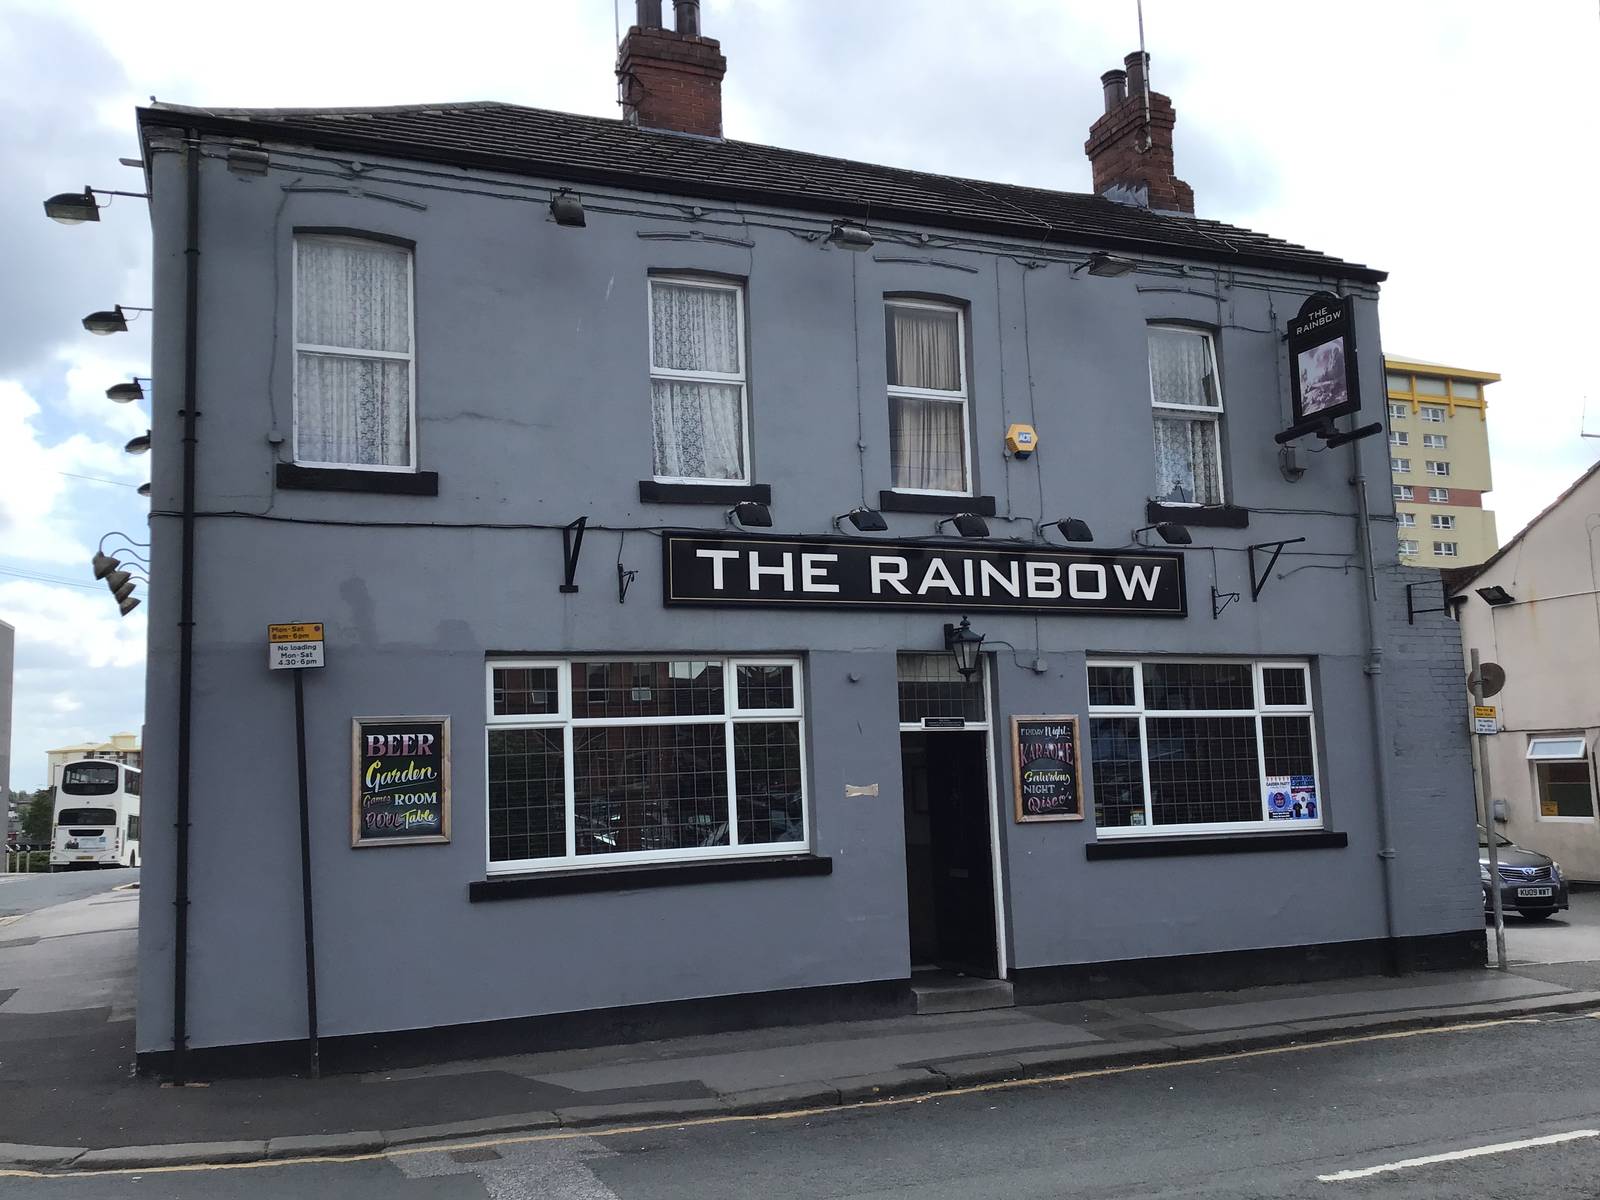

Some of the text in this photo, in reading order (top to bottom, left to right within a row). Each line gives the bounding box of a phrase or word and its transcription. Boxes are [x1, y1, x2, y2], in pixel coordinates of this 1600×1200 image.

[1296, 311, 1341, 335] RAINBOW
[1308, 307, 1328, 320] THE
[696, 549, 1162, 601] THE RAINBOW
[1021, 726, 1067, 738] FRIDAY Night
[366, 733, 435, 757] BEER
[1020, 742, 1074, 767] KARAOKE
[365, 760, 438, 793] Garden
[1024, 771, 1071, 785] Saturday
[1023, 785, 1056, 794] NIGHT
[363, 792, 438, 808] Games ROOM
[401, 809, 438, 829] Table
